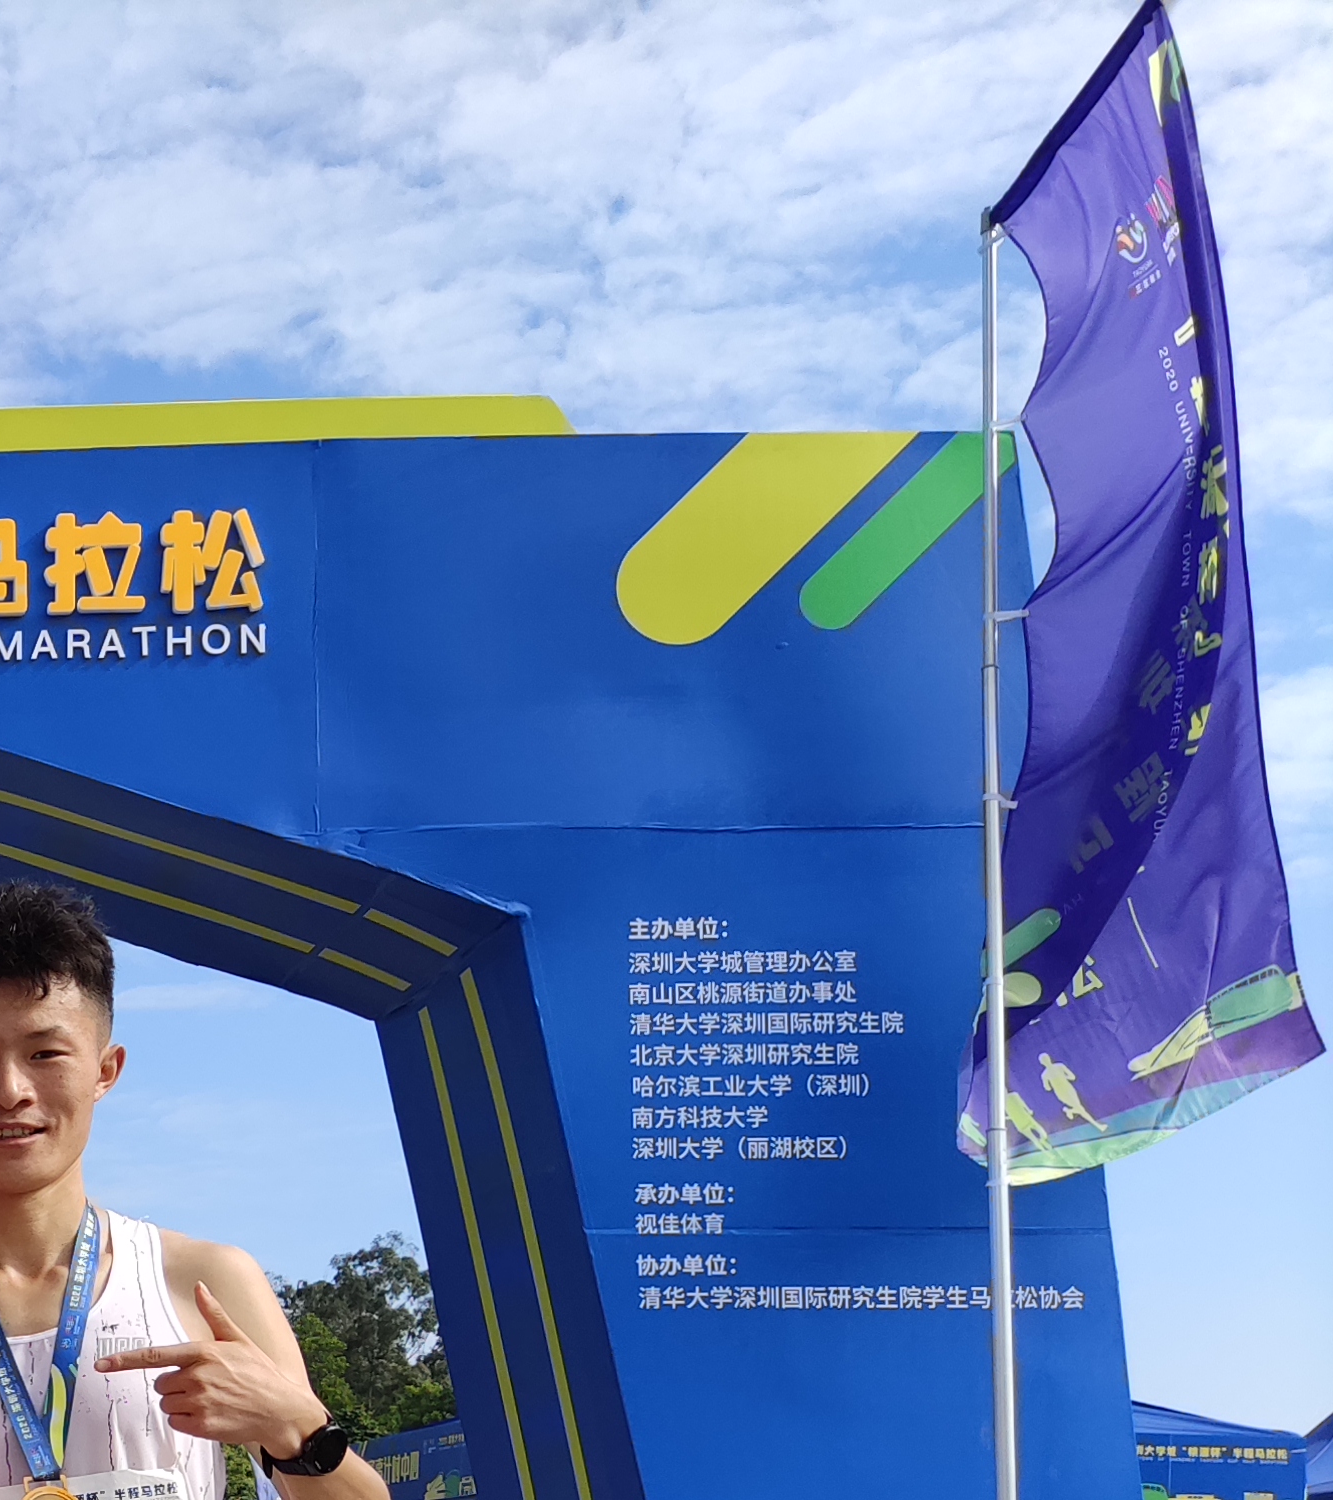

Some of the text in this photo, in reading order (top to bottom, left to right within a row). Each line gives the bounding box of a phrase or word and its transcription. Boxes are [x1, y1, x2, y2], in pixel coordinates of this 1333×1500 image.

[1158, 346, 1179, 392] 2020
[1181, 530, 1193, 588] TOWN
[628, 950, 858, 974] 深圳大学城管理办公室
[628, 981, 858, 1005] 南山区桃源街道办事处
[629, 1012, 905, 1035] 清华大学深圳国际研究生院
[630, 1043, 860, 1067] 北京大学深圳研究生院
[632, 1106, 769, 1129] 南方科技大学
[634, 1213, 725, 1236] 视佳体育
[638, 1286, 1085, 1310] 清华大学深圳国际研究生院学生马松协会
